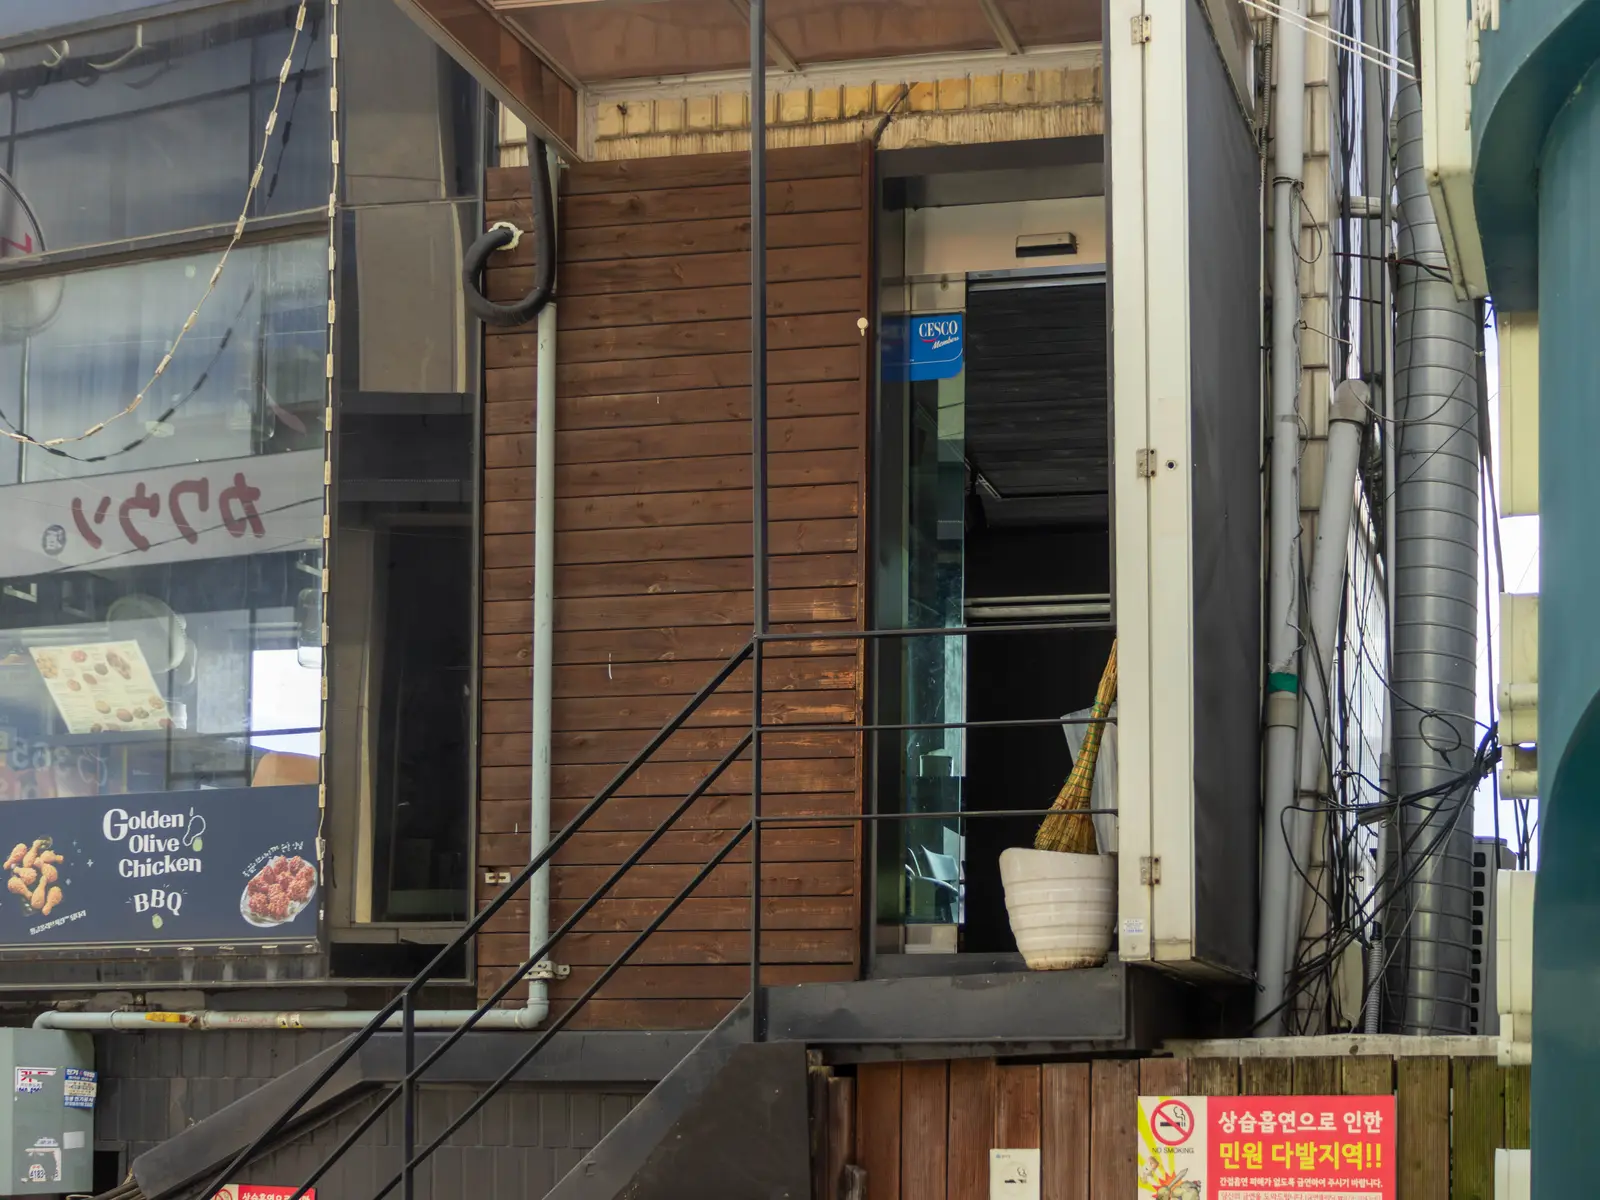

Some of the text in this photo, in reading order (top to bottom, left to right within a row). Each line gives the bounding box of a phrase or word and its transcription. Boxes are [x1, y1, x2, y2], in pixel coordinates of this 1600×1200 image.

[919, 320, 958, 338] CESCO
[103, 808, 184, 841] Golden
[128, 834, 180, 854] Olive
[118, 854, 202, 878] Chicken
[133, 888, 183, 916] BBQ
[1218, 1110, 1383, 1134] 상습흡연으로 인한
[1219, 1141, 1382, 1171] 민원 다발지역!!
[1219, 1176, 1249, 1187] 간접흡연
[1249, 1176, 1272, 1187] 피해가
[1297, 1177, 1326, 1188] 금연하여
[1328, 1177, 1350, 1189] 주시기
[1351, 1178, 1383, 1189] 바랍니다.
